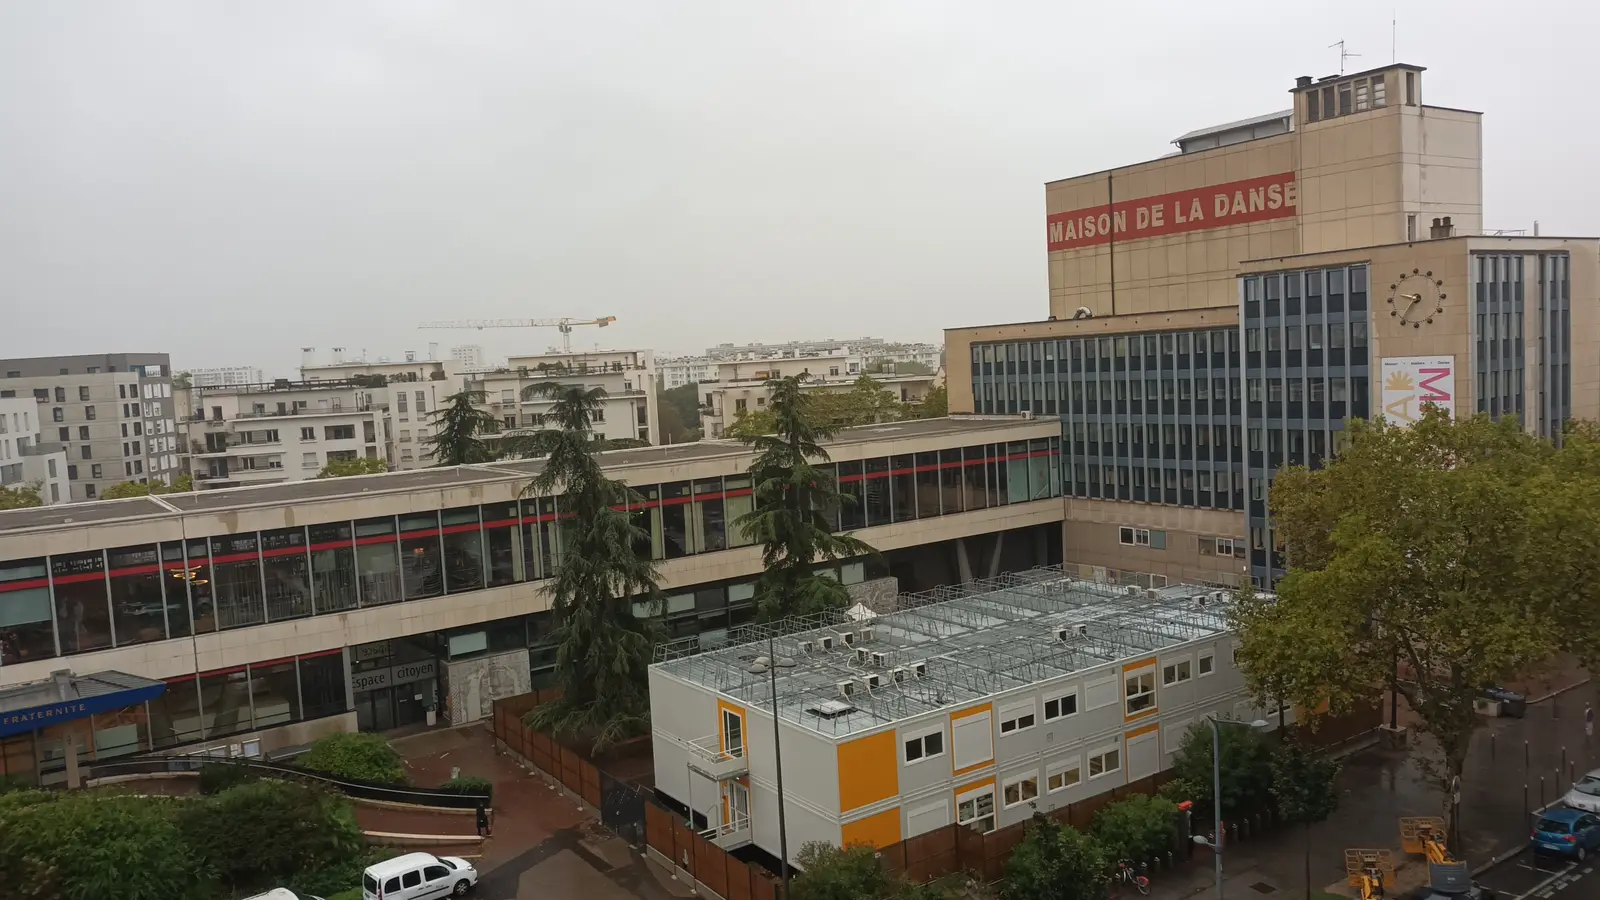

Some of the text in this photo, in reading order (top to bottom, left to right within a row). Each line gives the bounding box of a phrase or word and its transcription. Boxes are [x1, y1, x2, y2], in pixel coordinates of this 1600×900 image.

[1049, 182, 1297, 243] MAISON DE LA DANSE
[397, 663, 434, 679] citoyen
[3, 703, 86, 725] FRATERNITE
